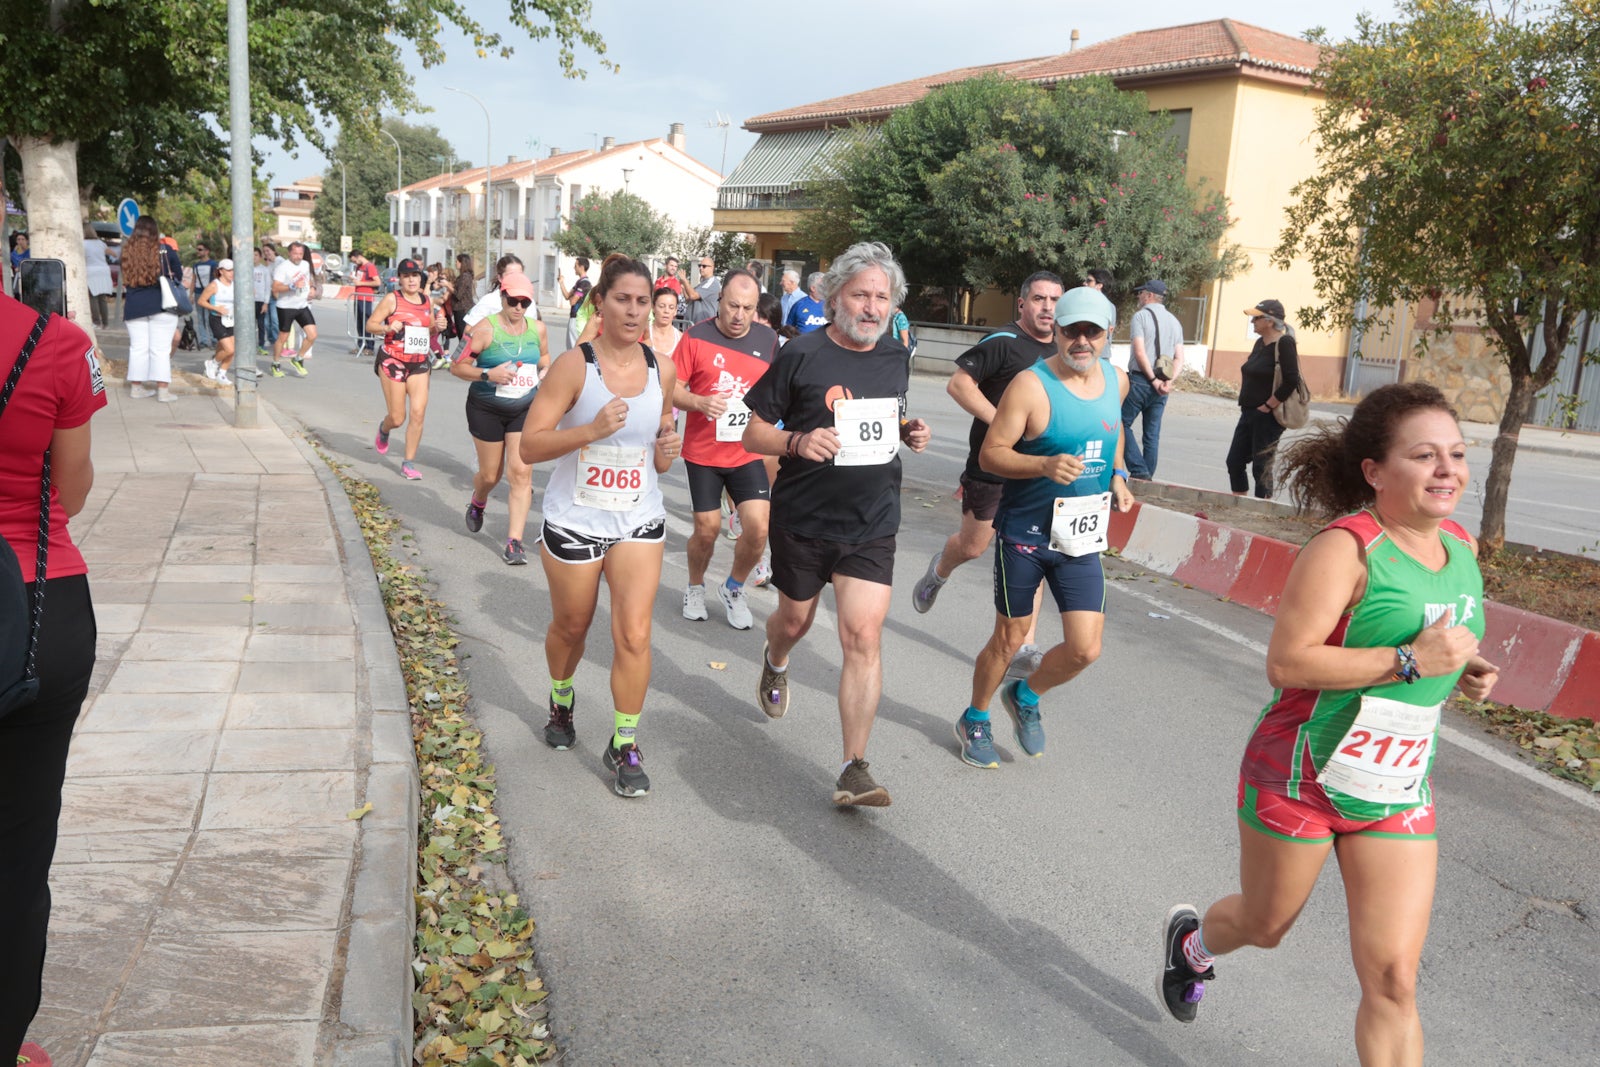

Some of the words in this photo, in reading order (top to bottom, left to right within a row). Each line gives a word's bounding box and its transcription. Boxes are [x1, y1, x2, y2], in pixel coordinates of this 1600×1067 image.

[408, 336, 428, 347] 3069
[859, 421, 883, 441] 89
[586, 466, 641, 489] 2068
[1069, 514, 1099, 536] 163
[1340, 730, 1428, 767] 2172
